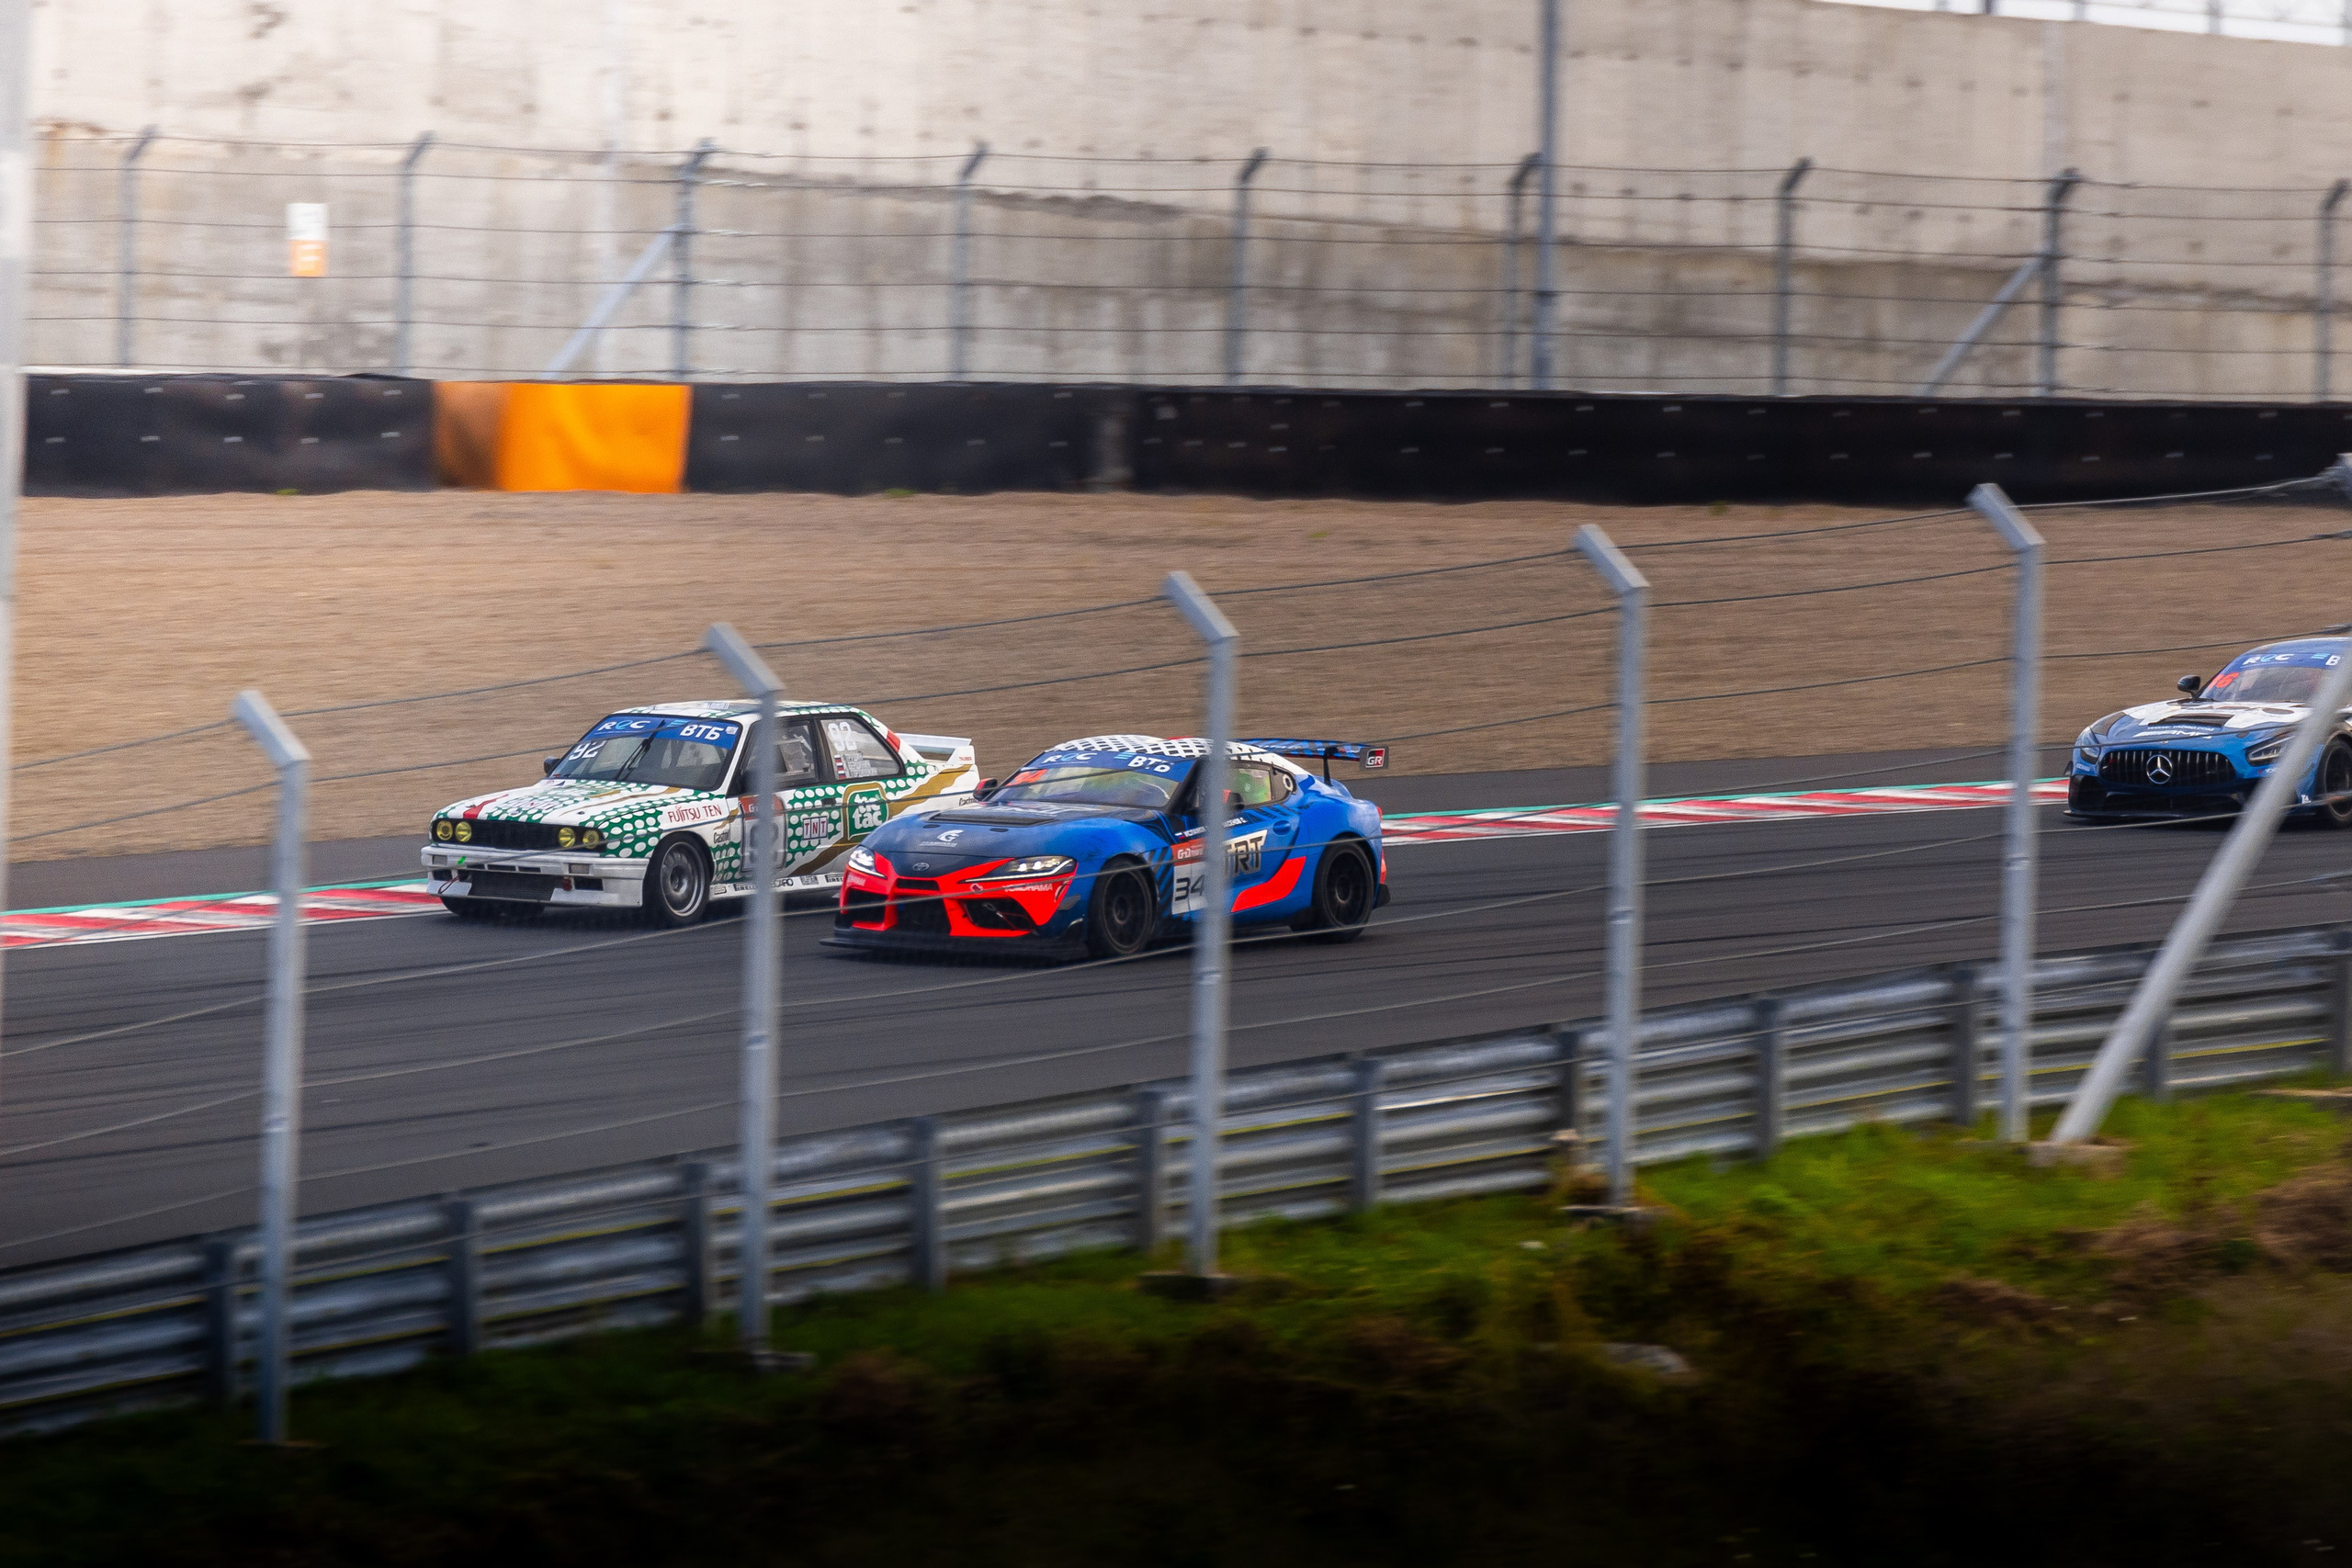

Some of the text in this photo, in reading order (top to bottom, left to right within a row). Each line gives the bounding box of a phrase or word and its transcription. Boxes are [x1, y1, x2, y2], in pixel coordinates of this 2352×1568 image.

[568, 740, 607, 761] 92
[1367, 755, 1383, 765] GR
[667, 804, 723, 823] FUJITSU TEN
[854, 794, 881, 814] tic
[804, 820, 826, 836] TNT
[852, 808, 883, 829] tac
[1174, 874, 1205, 902] 34
